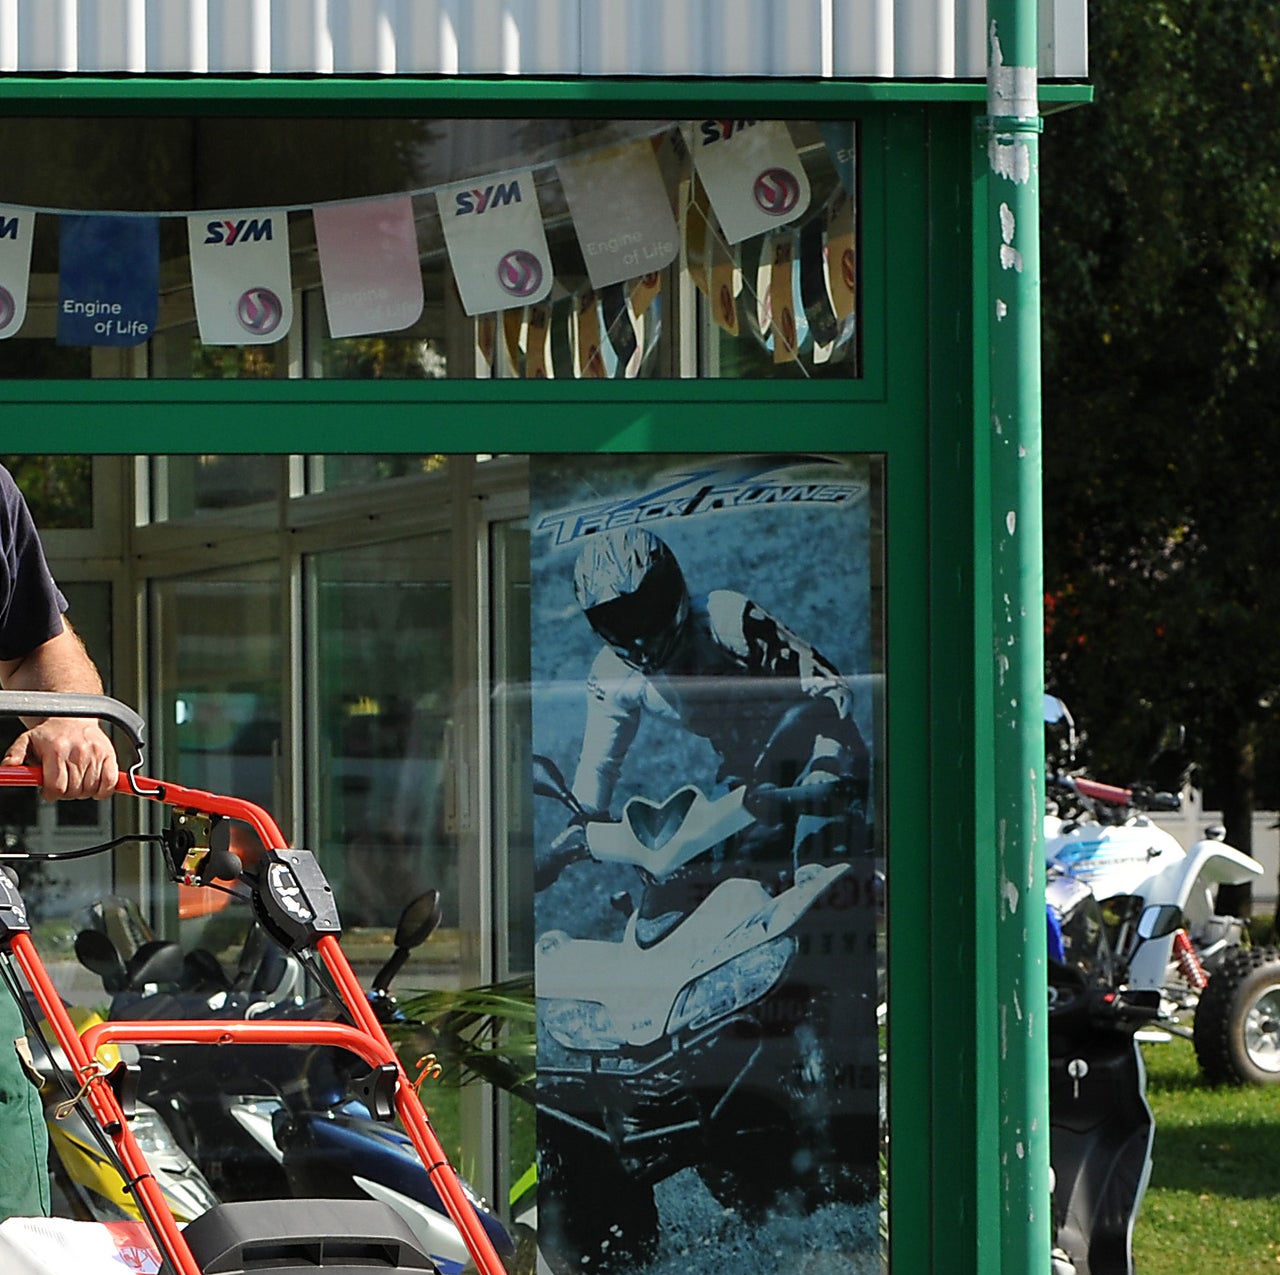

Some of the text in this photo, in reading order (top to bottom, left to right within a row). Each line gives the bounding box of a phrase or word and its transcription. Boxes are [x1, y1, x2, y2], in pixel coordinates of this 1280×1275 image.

[455, 180, 522, 216] SYM
[204, 218, 273, 246] SYM
[63, 300, 122, 317] Engine
[94, 318, 149, 336] of Life
